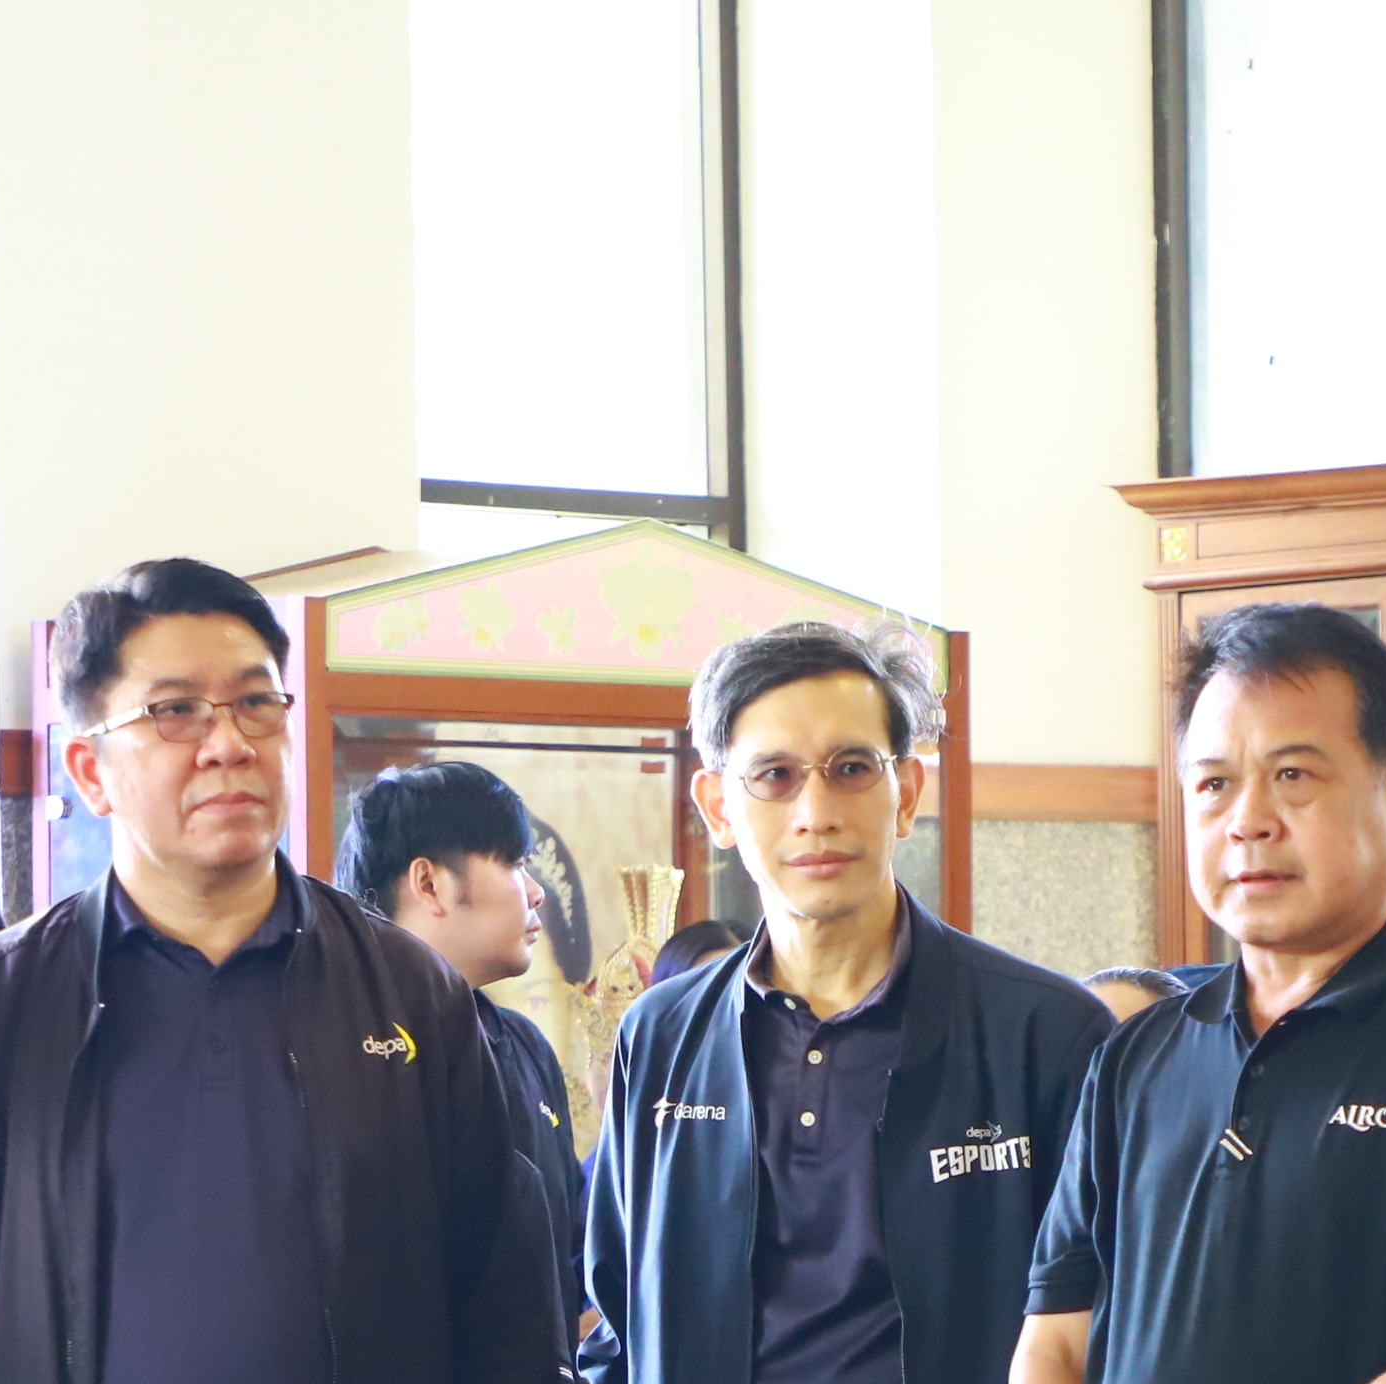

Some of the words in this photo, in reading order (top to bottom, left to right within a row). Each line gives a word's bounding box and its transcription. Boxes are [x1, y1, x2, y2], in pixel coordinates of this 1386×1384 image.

[362, 1035, 408, 1060] depa
[966, 1126, 992, 1139] depa
[930, 1136, 1031, 1184] ESPORTS
